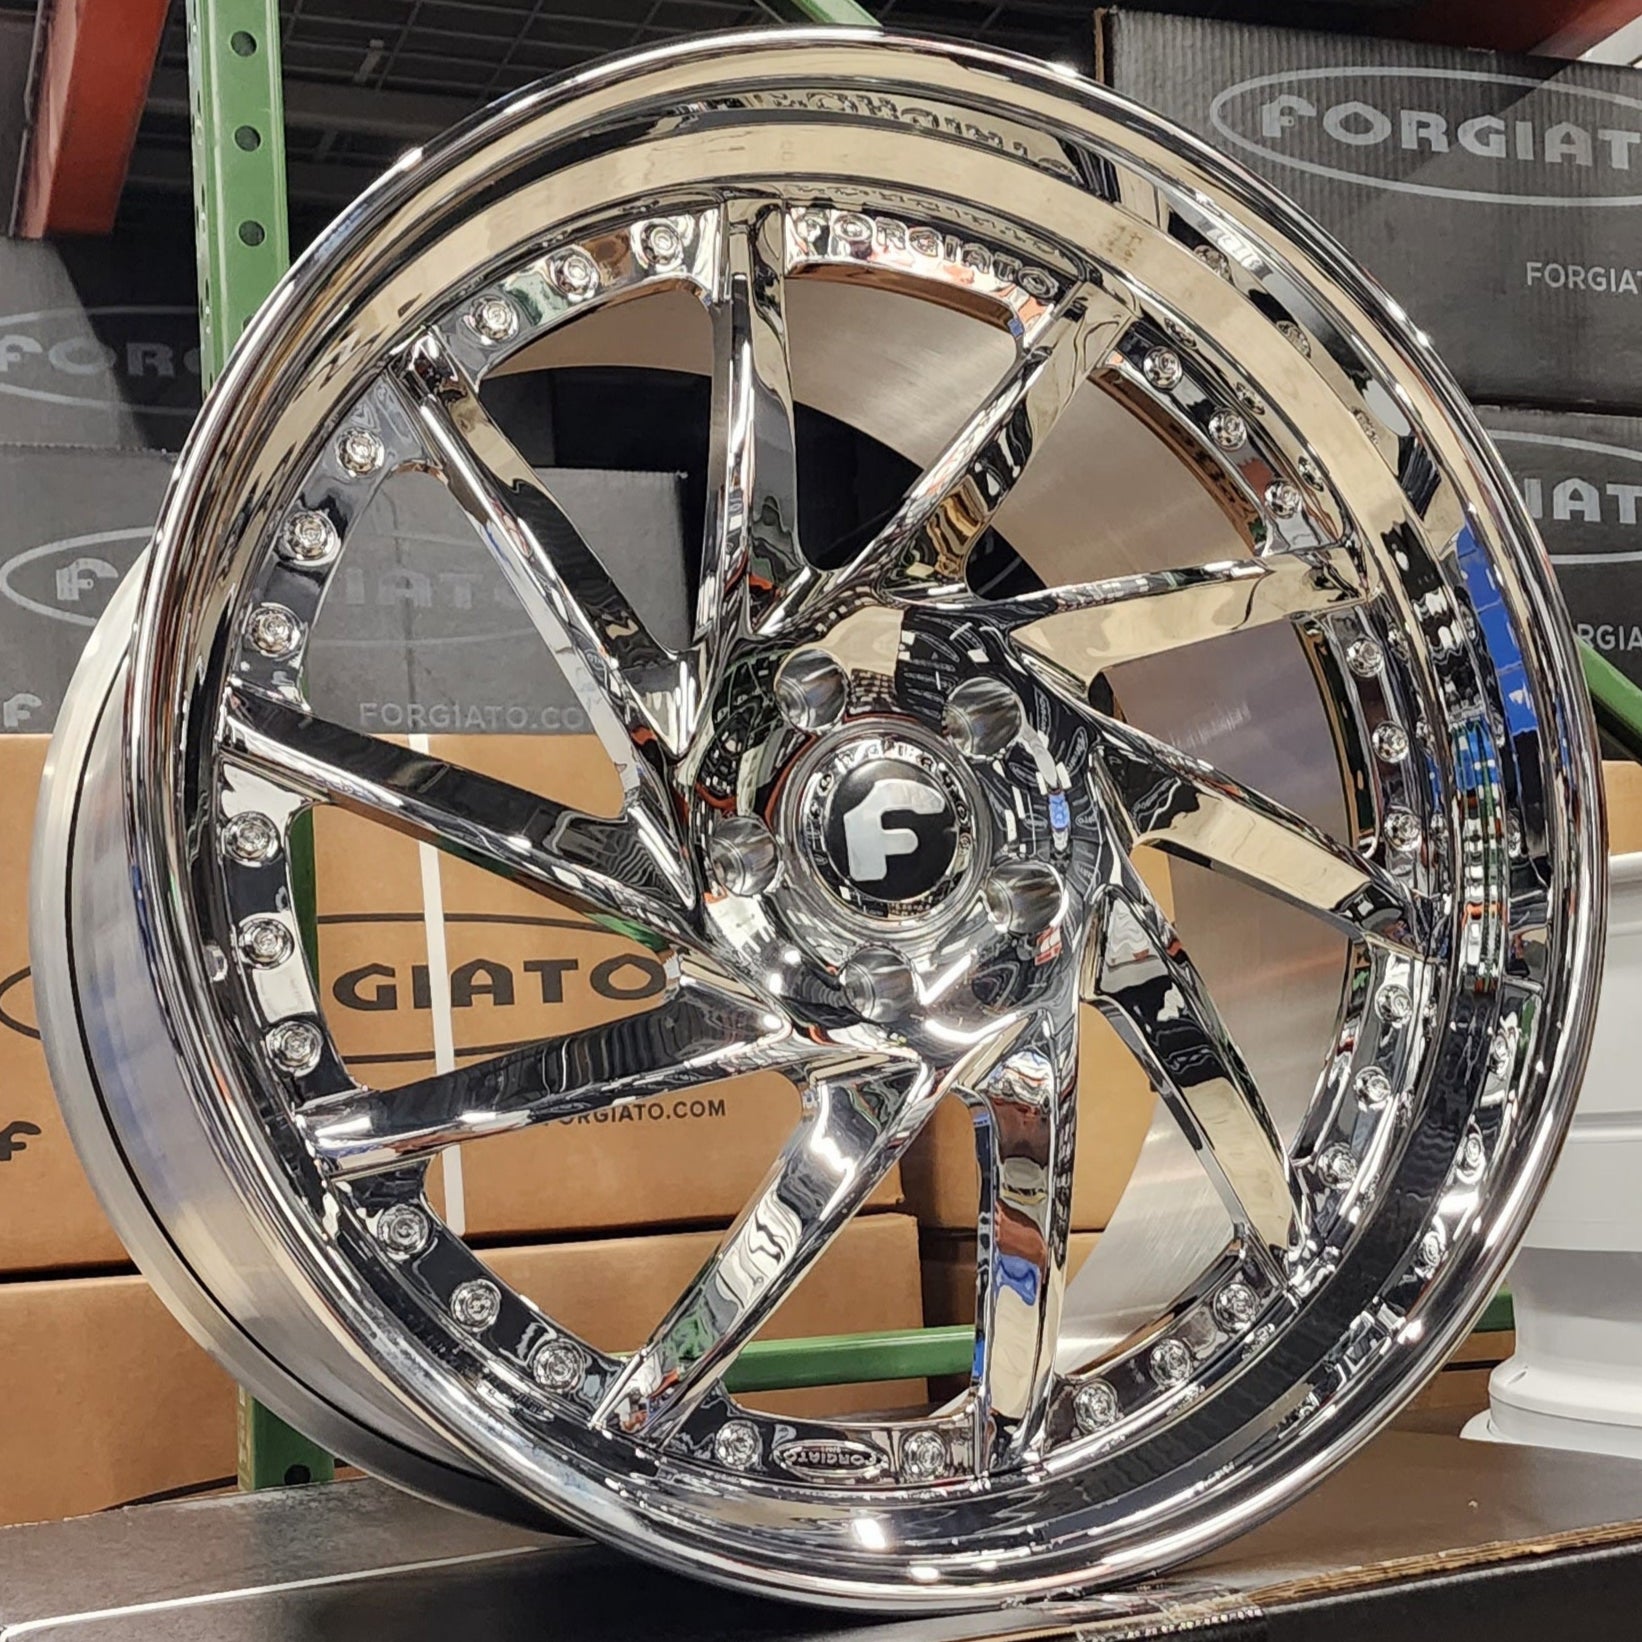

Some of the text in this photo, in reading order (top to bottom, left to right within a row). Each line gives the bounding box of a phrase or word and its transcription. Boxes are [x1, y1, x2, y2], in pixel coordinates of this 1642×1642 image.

[1526, 261, 1642, 294] FORGIA
[359, 702, 588, 730] FORGIATO.CO
[843, 778, 945, 882] F
